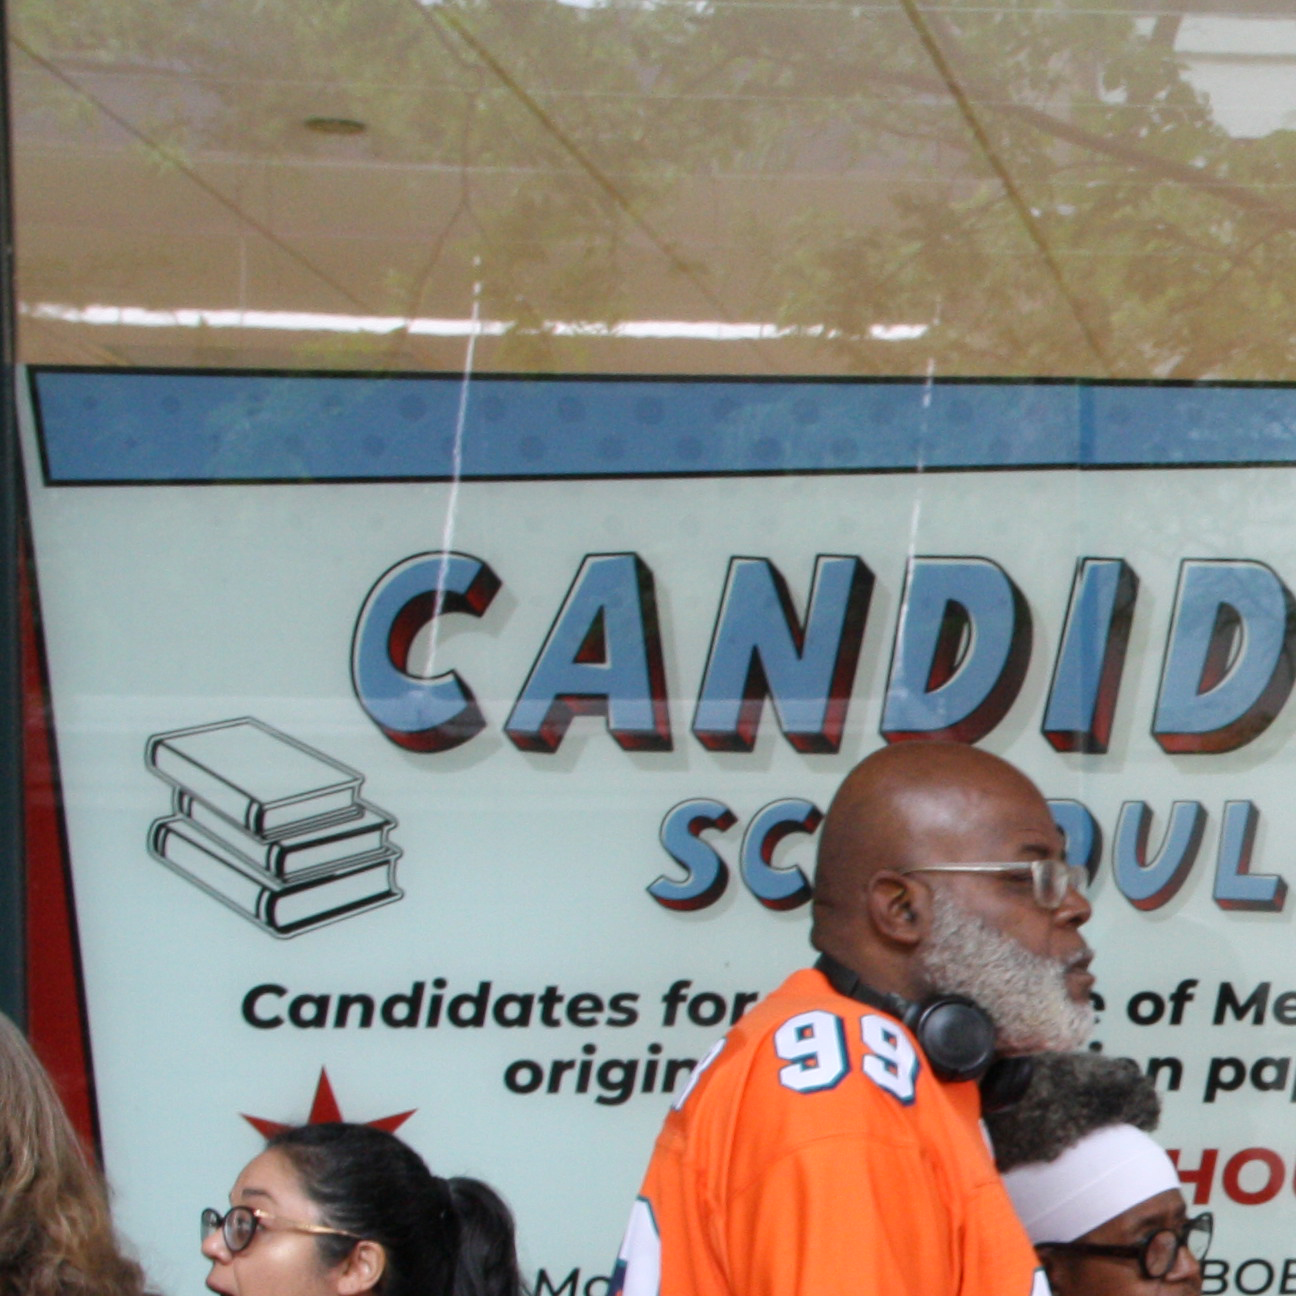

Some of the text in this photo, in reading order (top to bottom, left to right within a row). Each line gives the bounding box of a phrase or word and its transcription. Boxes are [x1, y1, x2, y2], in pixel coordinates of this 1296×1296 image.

[241, 977, 640, 1030] Candidates
[661, 979, 759, 1028] for
[1126, 978, 1200, 1026] of
[503, 1042, 699, 1106] origin
[773, 1008, 921, 1106] 99
